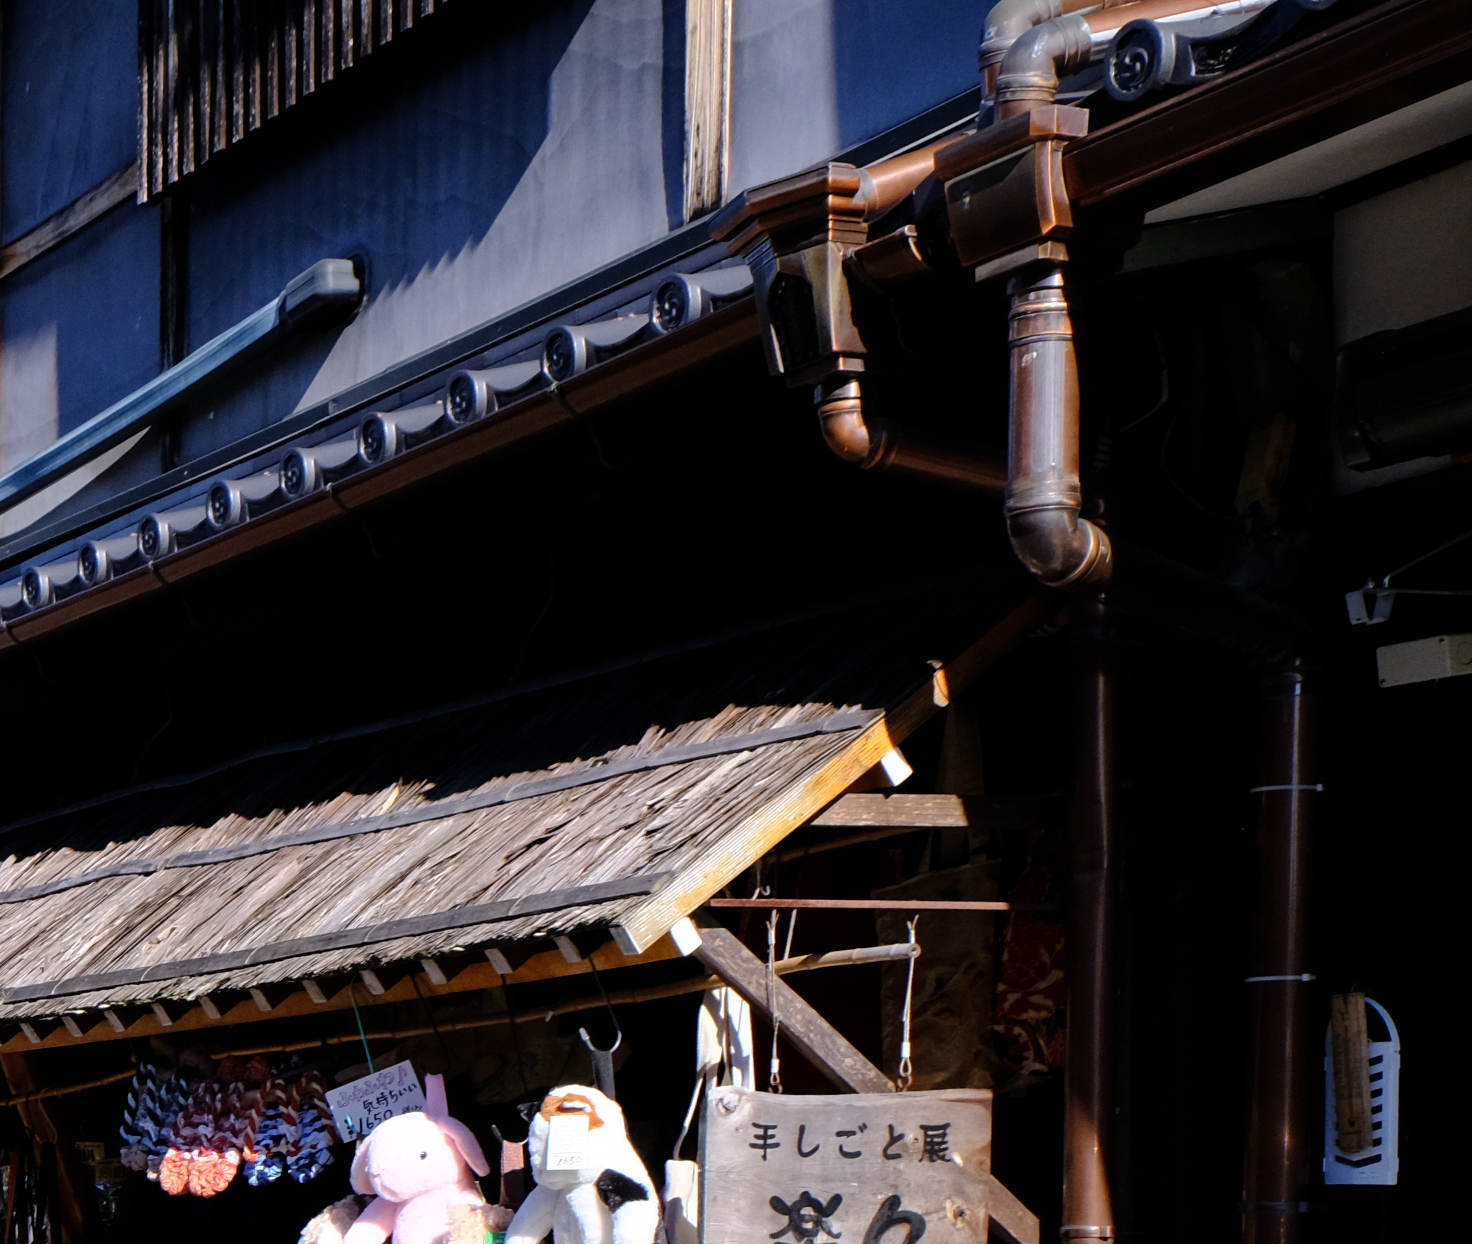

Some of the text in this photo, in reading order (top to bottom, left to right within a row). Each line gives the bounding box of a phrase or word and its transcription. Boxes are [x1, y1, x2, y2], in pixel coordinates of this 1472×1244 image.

[749, 1121, 954, 1164] 手しごと展
